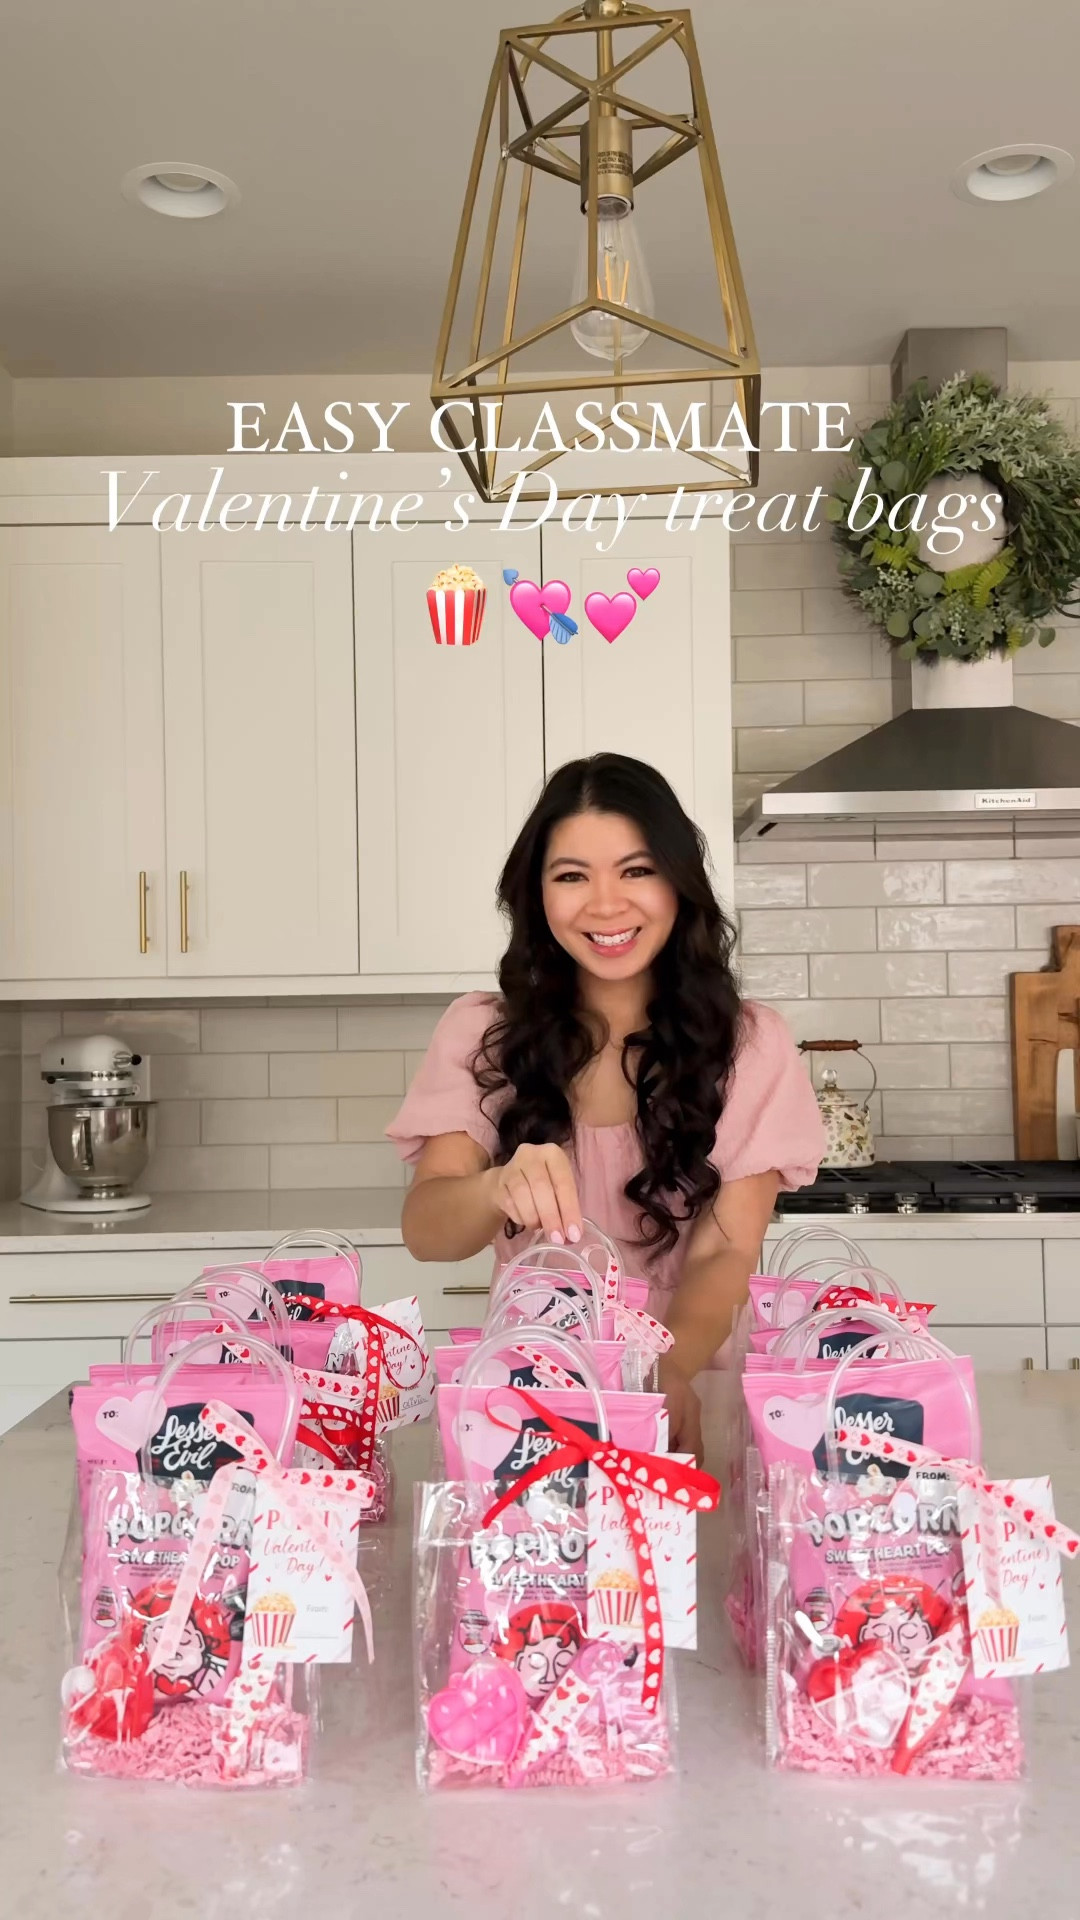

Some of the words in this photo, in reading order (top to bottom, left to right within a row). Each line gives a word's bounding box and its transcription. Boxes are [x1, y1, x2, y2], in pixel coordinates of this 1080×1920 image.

[102, 1410, 119, 1419] TO:
[769, 1410, 785, 1421] TO:
[163, 1437, 218, 1471] Evil
[915, 1471, 950, 1481] FROM:
